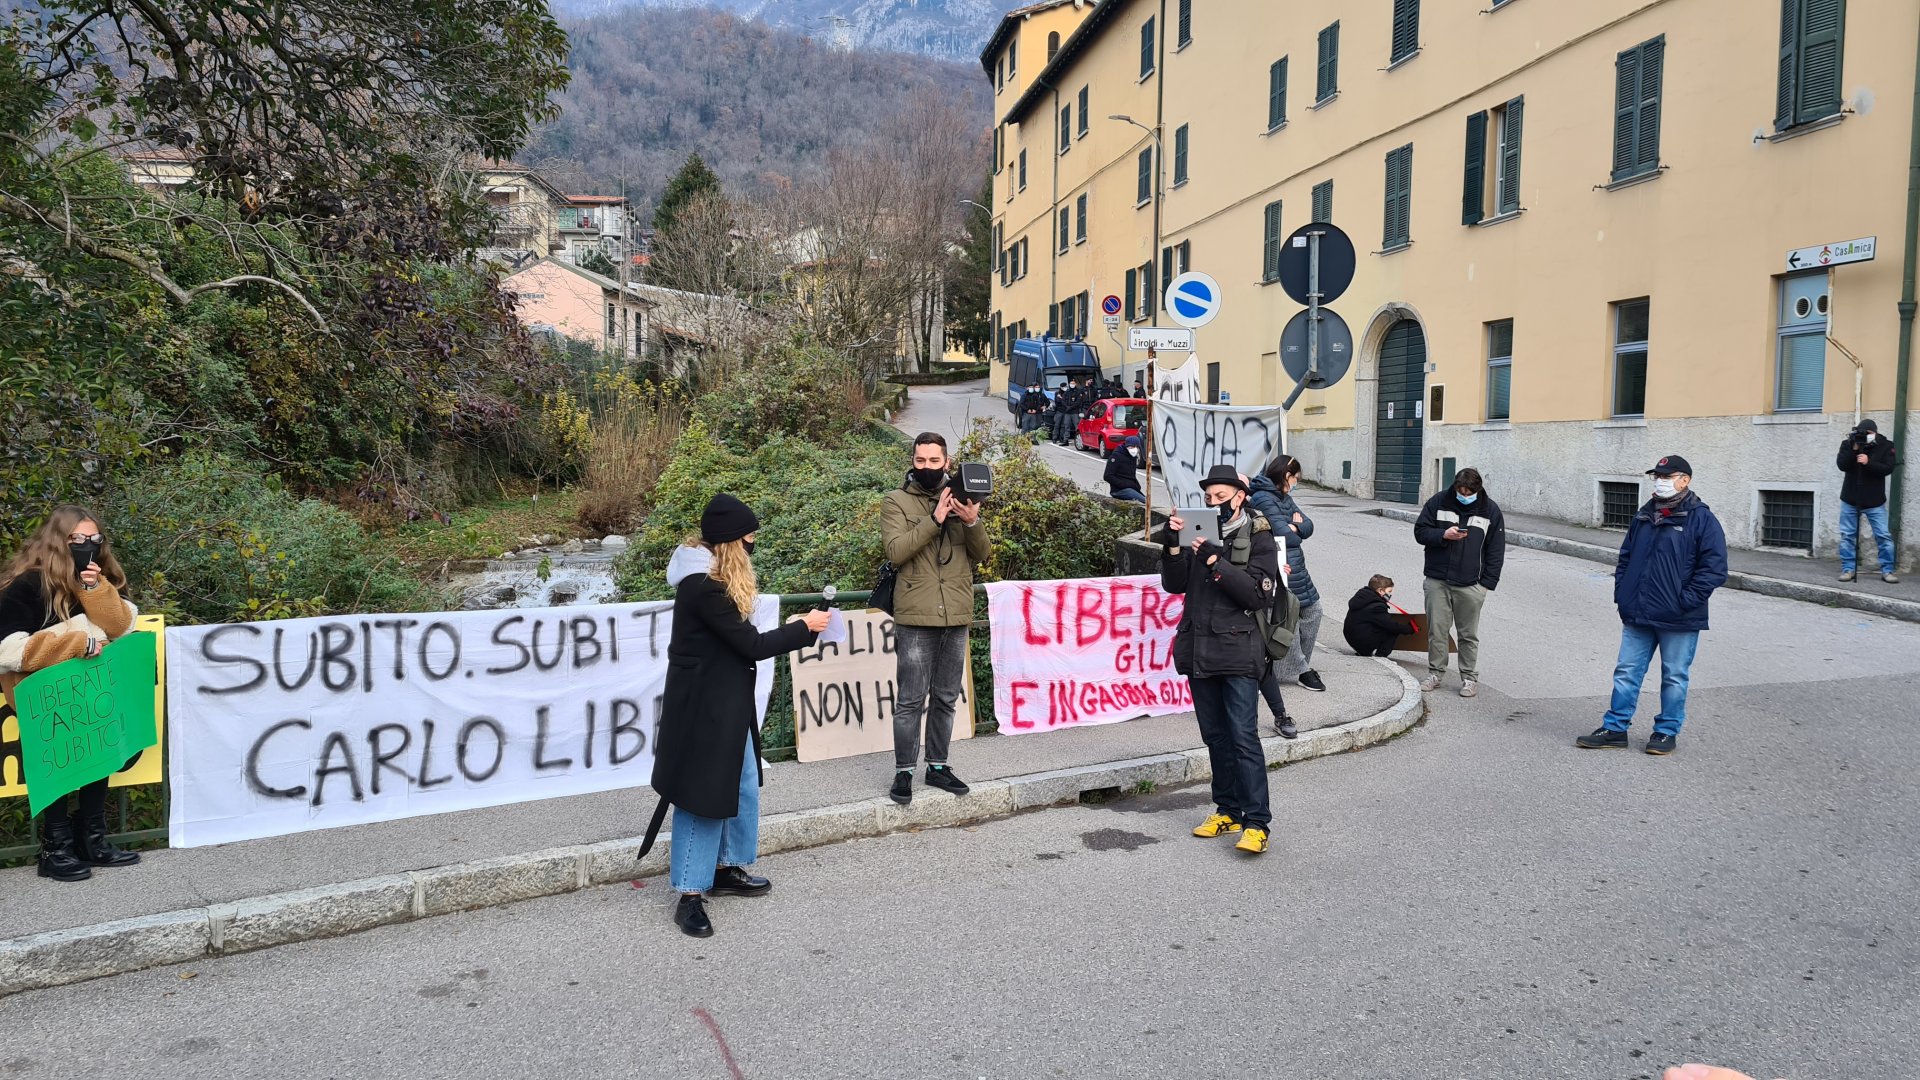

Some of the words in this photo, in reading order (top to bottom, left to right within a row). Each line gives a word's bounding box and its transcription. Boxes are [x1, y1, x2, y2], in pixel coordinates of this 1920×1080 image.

[1834, 243, 1872, 256] CasAmica
[197, 620, 473, 694] SUBITO.
[28, 658, 118, 720] LIBERATE
[800, 681, 863, 732] NON
[1011, 681, 1039, 728] E
[39, 691, 115, 743] CARLO
[245, 716, 507, 806] CARLO
